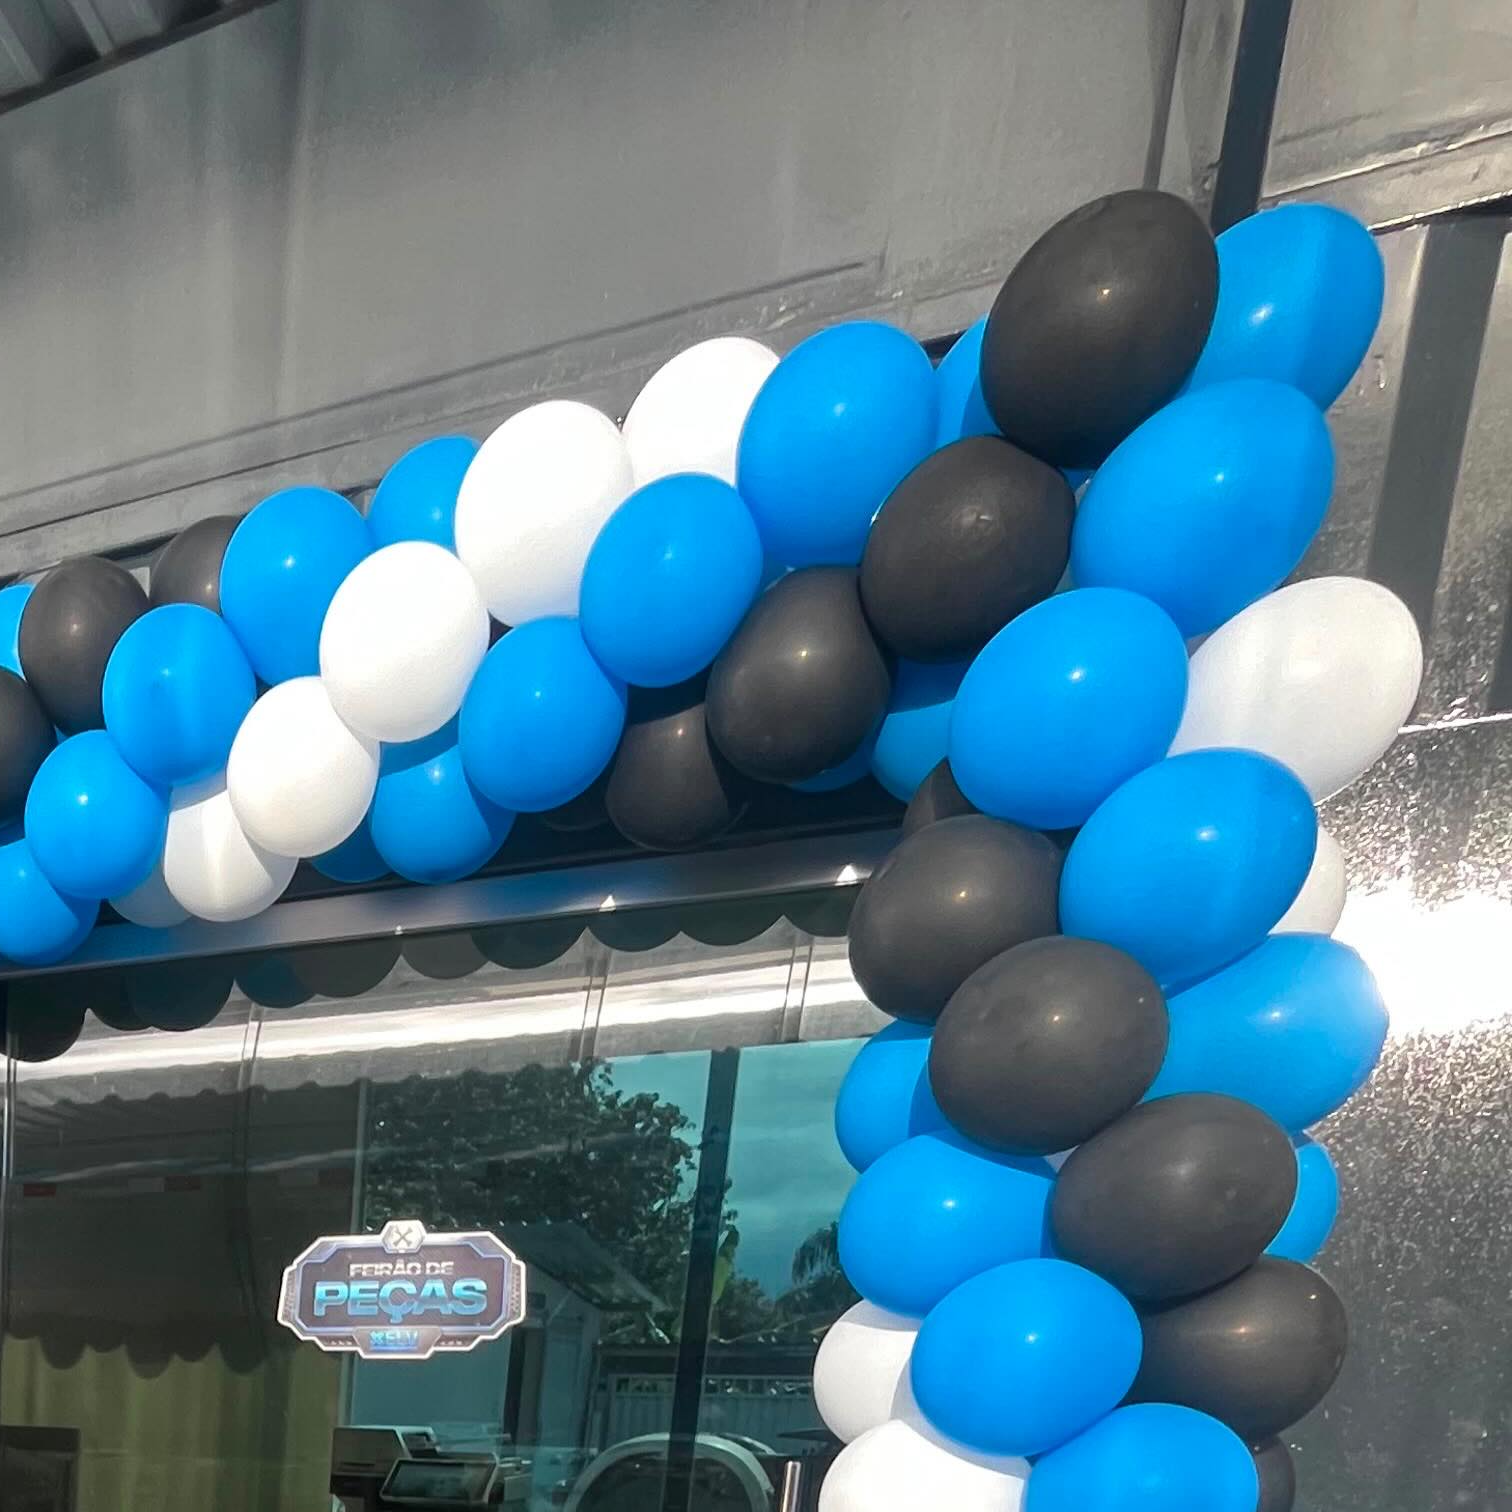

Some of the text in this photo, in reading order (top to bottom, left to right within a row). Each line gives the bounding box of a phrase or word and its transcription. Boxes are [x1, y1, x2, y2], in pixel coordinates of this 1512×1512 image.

[349, 1258, 421, 1277] FEIRÃO
[424, 1260, 454, 1276] DE
[313, 1278, 487, 1324] PEÇAS
